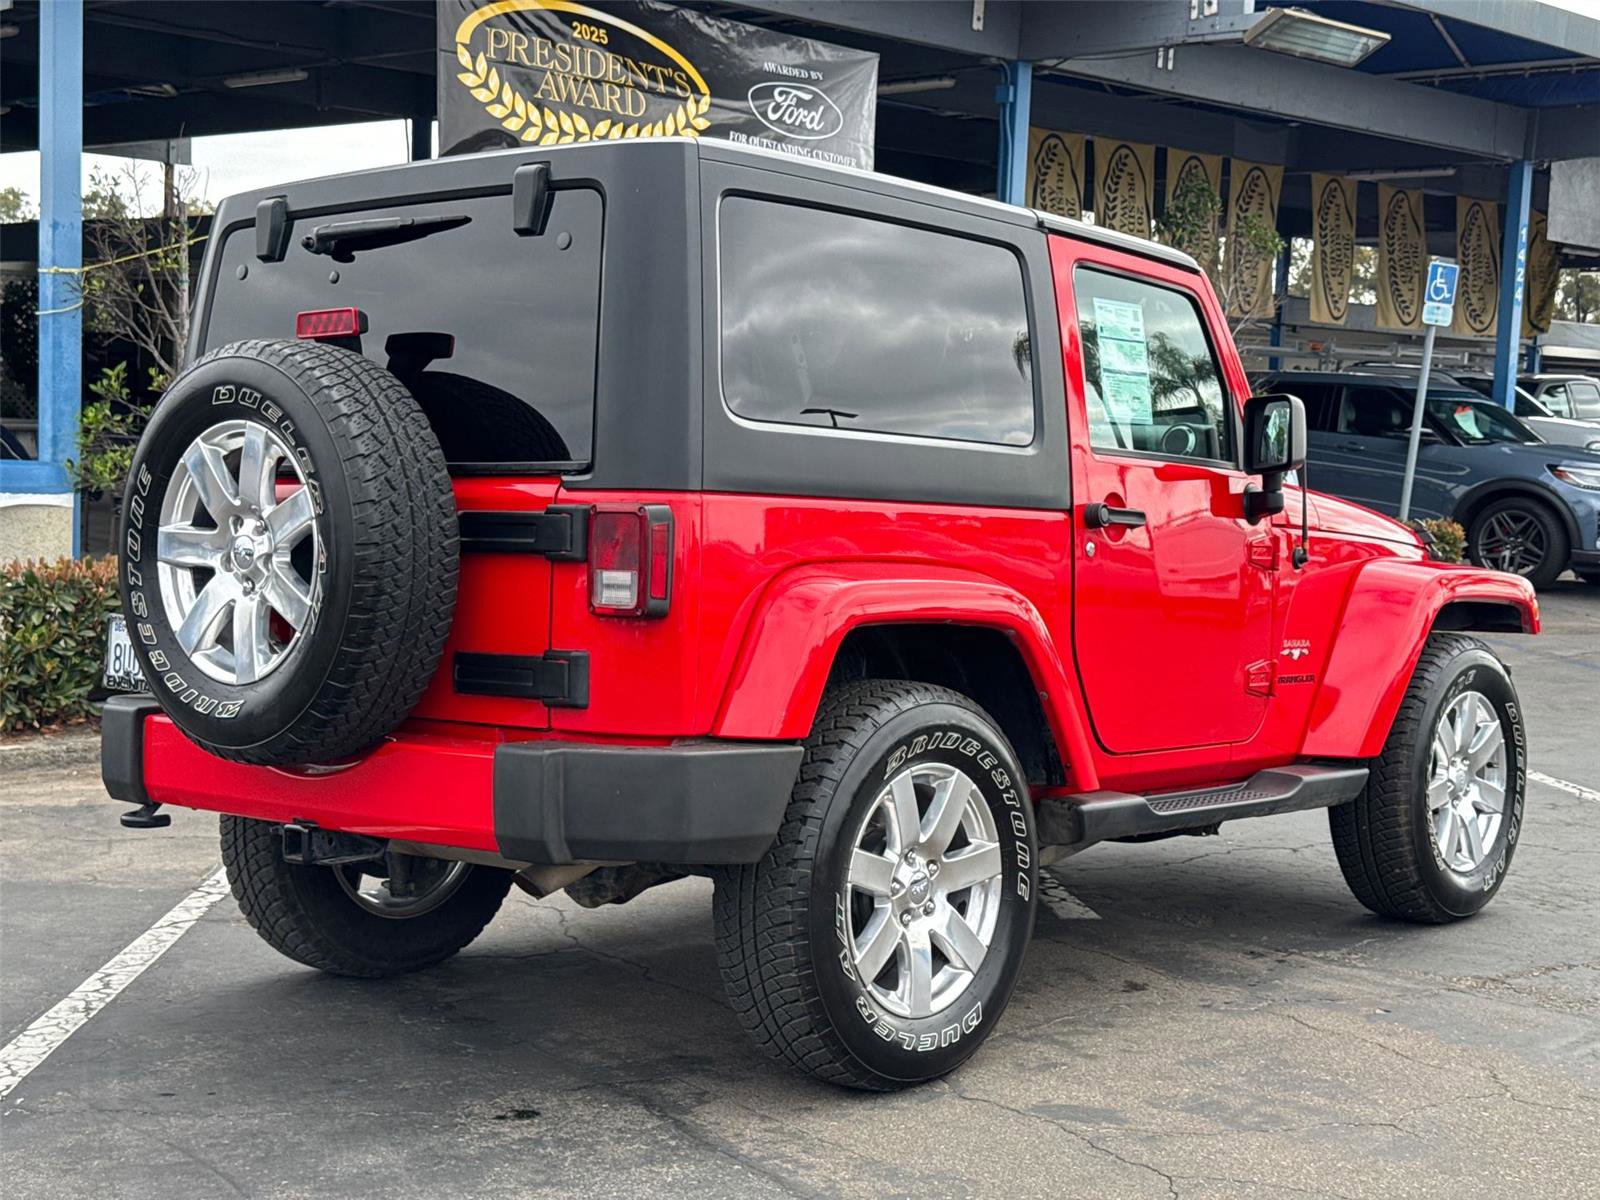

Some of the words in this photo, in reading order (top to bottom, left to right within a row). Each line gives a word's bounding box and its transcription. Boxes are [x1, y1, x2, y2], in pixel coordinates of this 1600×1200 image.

[571, 21, 608, 44] 2025
[485, 27, 692, 97] PRESIDENT'S
[763, 62, 808, 79] AWARDED
[810, 71, 824, 81] BY
[534, 70, 647, 118] AWARD
[766, 87, 825, 132] Ford
[729, 130, 747, 145] FOR
[748, 136, 811, 159] OUTSTANDING
[812, 150, 858, 168] CUSTOMER
[211, 384, 325, 516] DUELER
[127, 464, 245, 719] BRIDGESTONE
[1505, 702, 1525, 845] DUELER
[884, 733, 1030, 903] BRIDGESTONE
[854, 996, 983, 1053] DUELER
